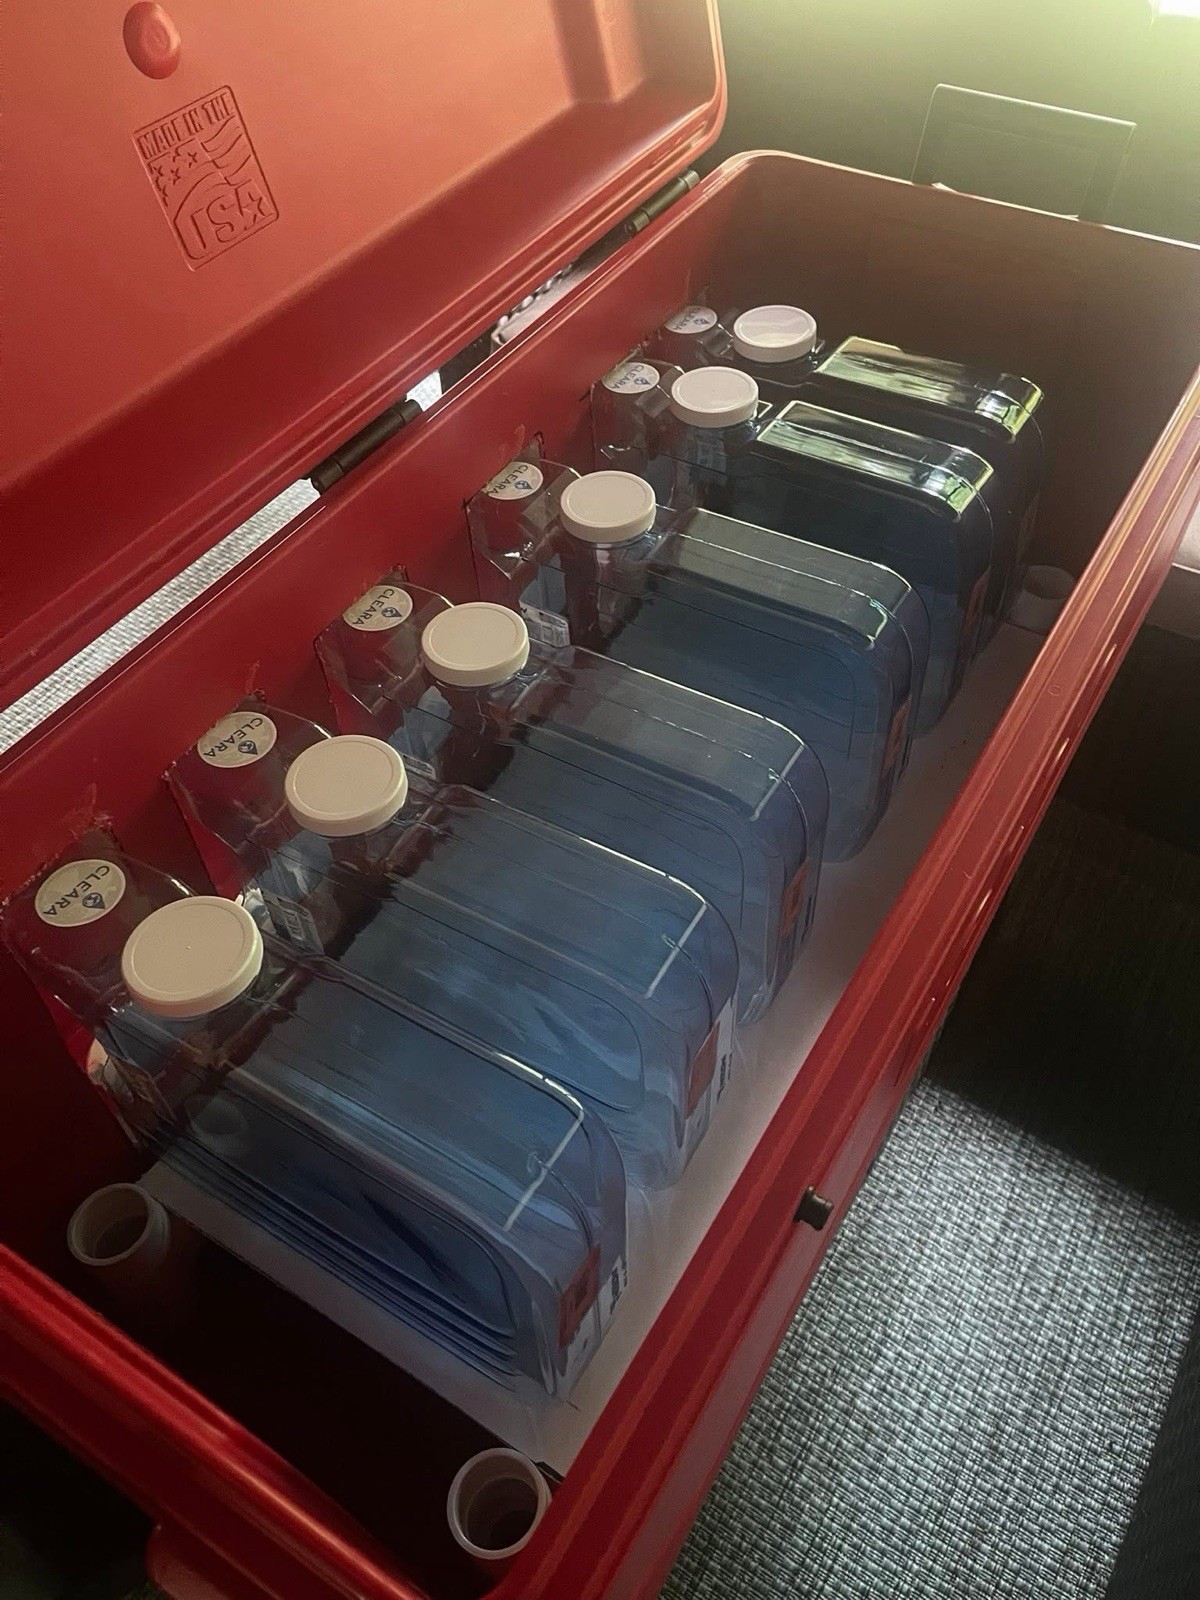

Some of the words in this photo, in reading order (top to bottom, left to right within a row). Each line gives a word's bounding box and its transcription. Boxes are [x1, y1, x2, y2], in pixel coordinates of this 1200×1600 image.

[136, 117, 181, 159] MADE
[183, 107, 204, 136] IN
[202, 92, 231, 124] THE
[173, 175, 275, 260] USA
[486, 464, 529, 494] CLEARA
[352, 588, 395, 625] CLEARA
[202, 717, 263, 757] CLEARA
[43, 865, 110, 916] CLEARA
